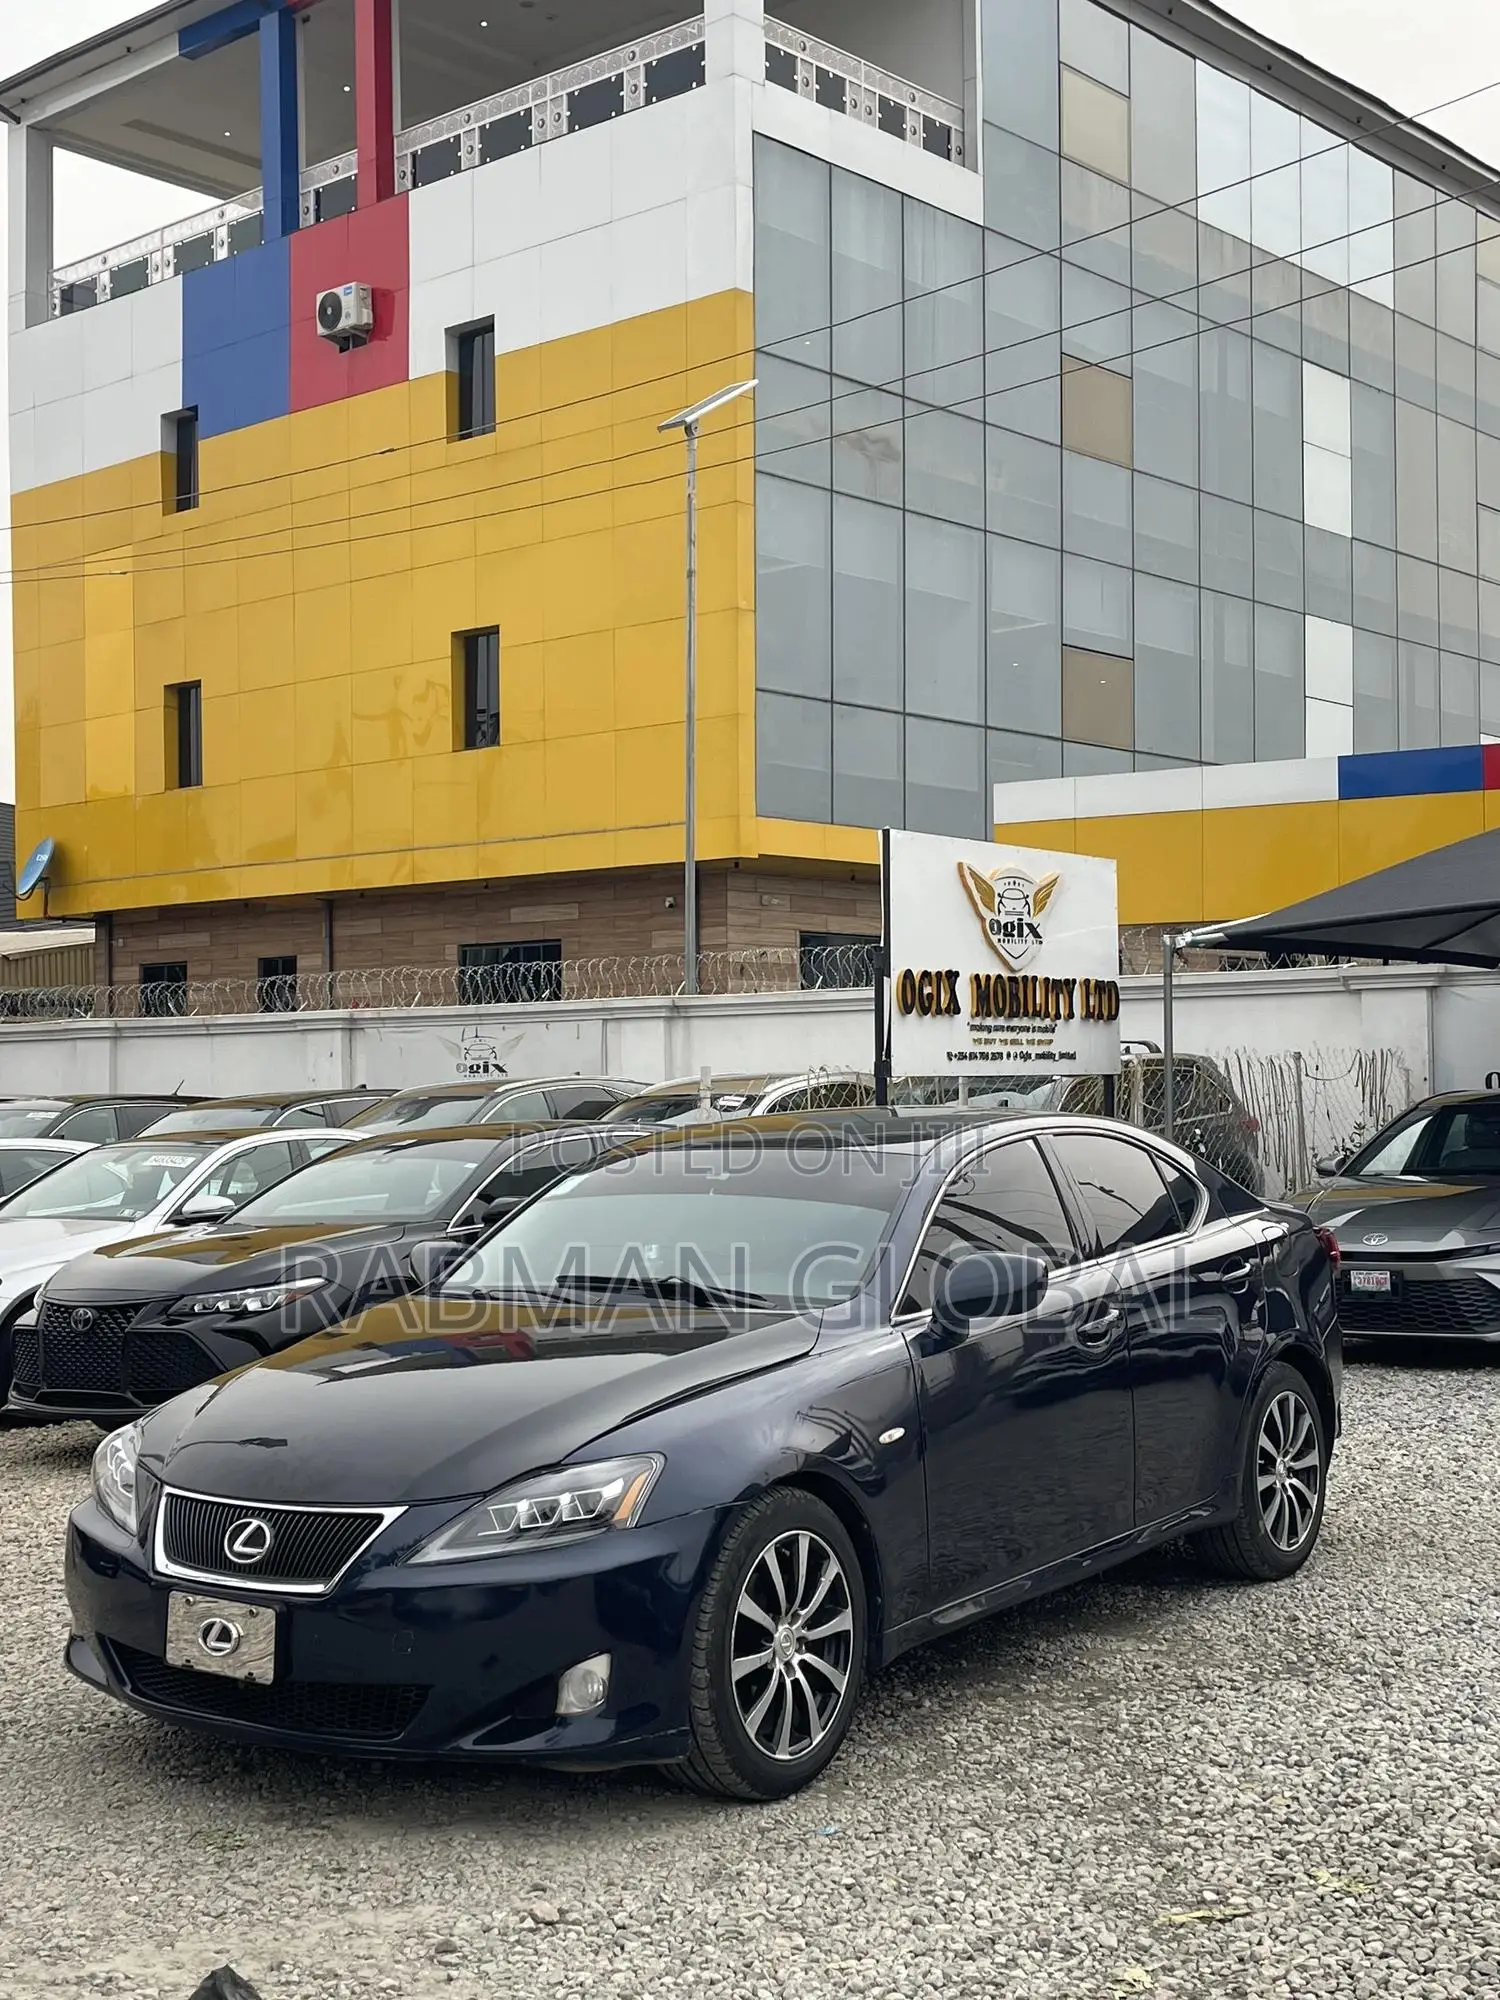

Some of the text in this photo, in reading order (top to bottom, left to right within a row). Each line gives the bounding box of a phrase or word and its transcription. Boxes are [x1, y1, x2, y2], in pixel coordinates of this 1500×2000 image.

[897, 968, 1120, 1021] OGIX MOBILITY LTD
